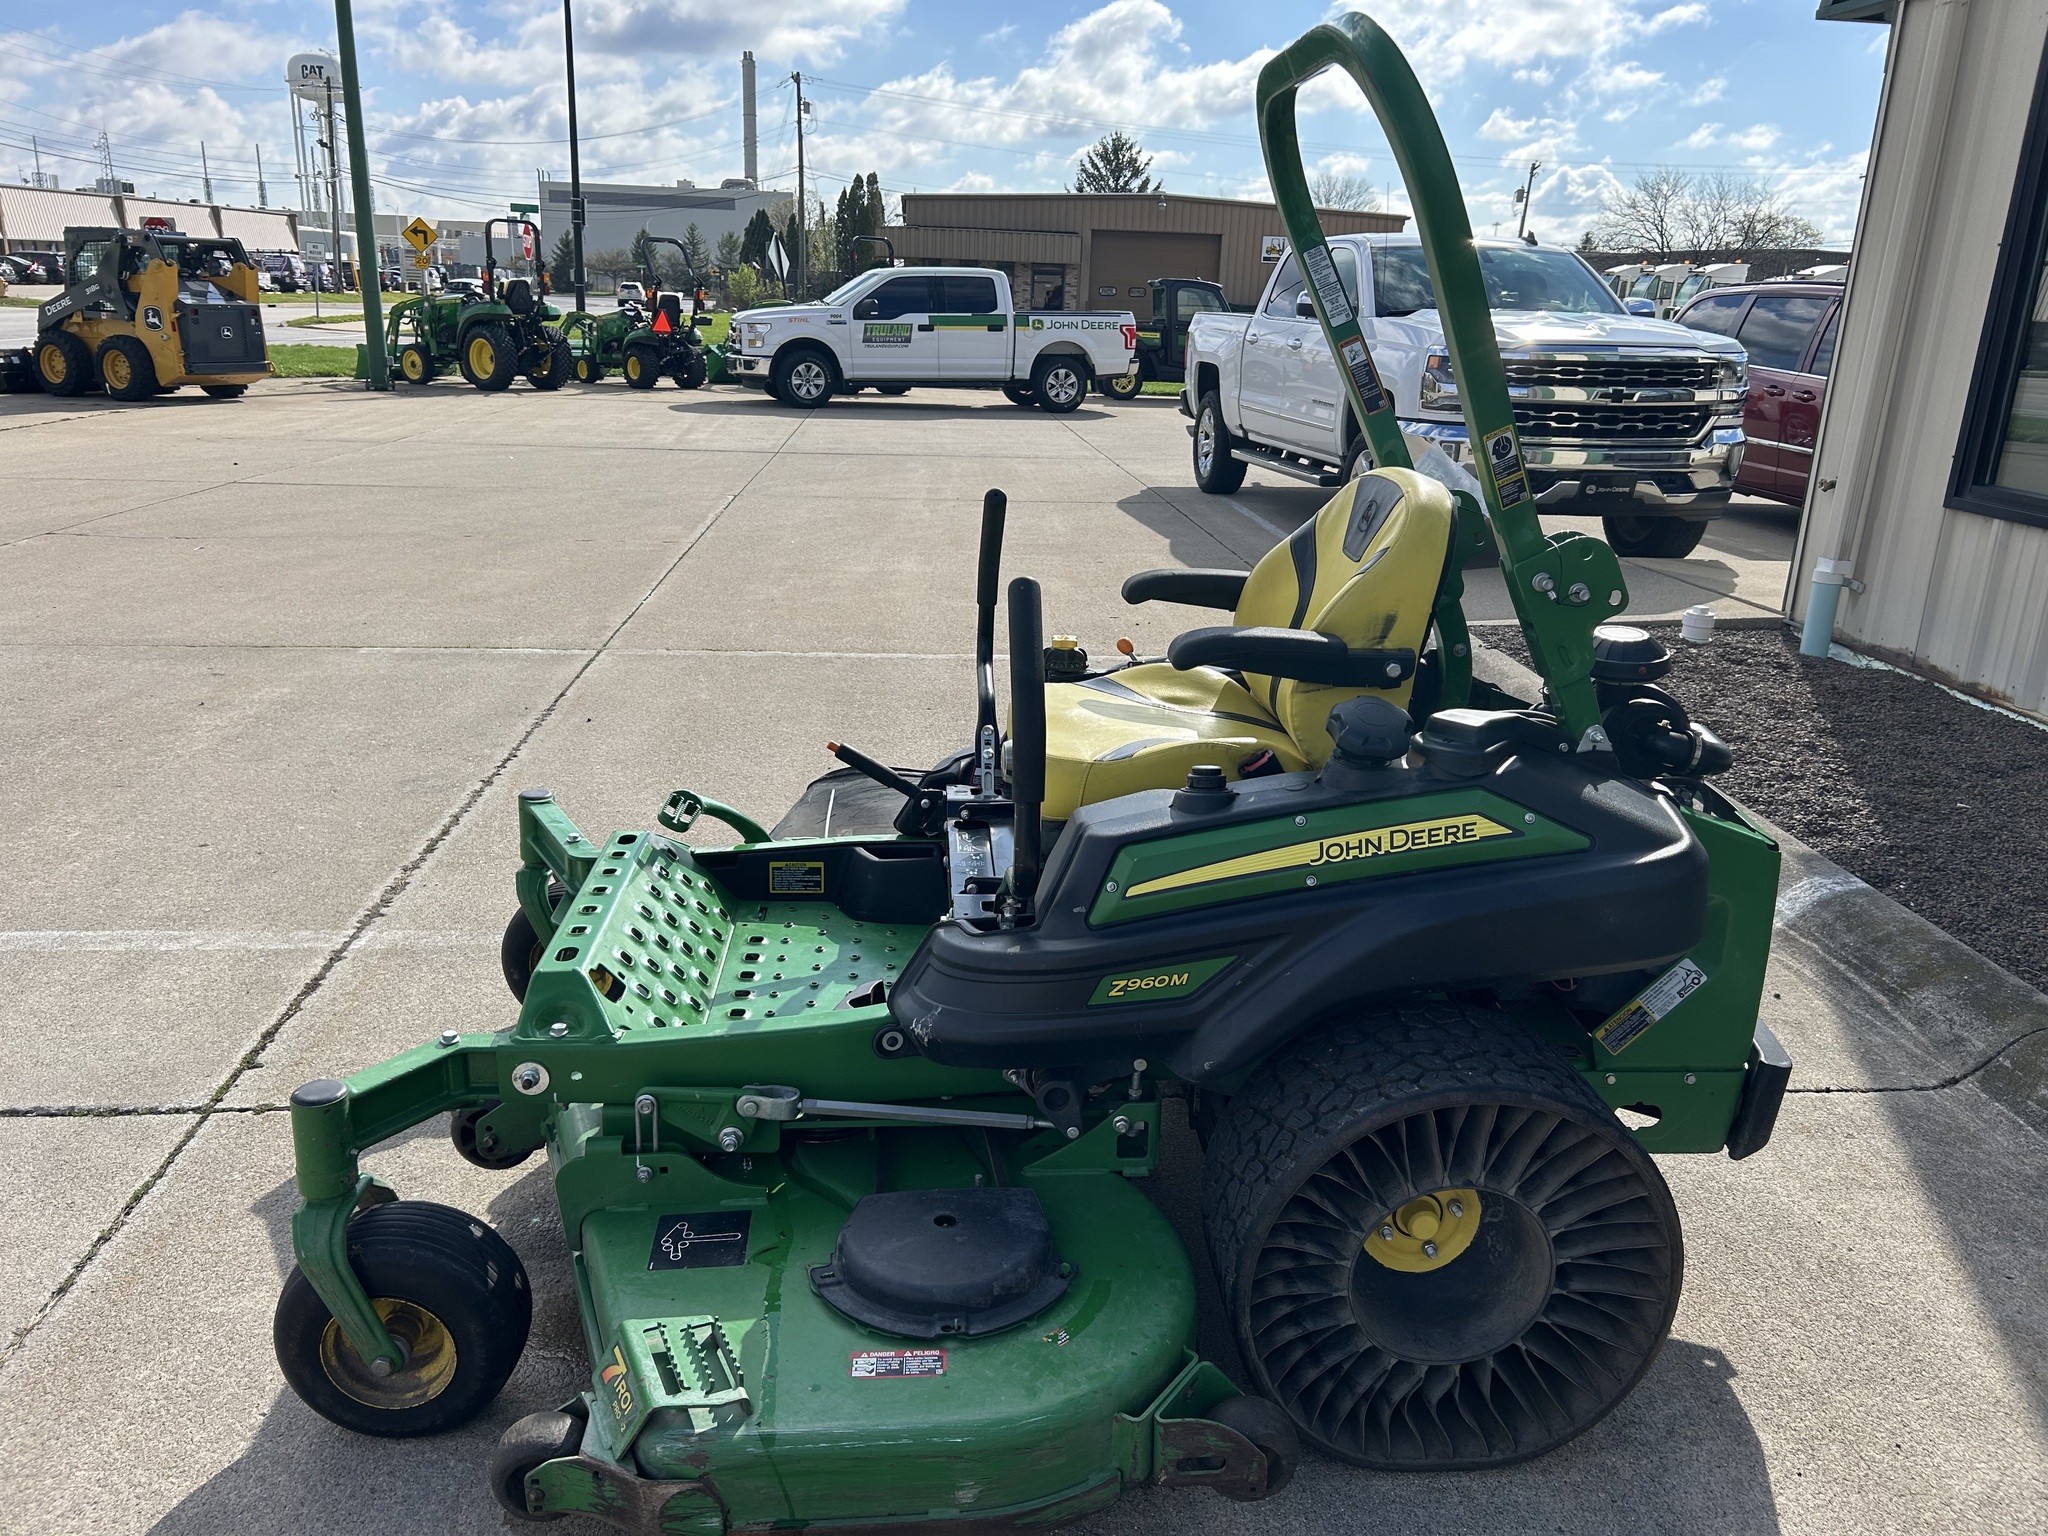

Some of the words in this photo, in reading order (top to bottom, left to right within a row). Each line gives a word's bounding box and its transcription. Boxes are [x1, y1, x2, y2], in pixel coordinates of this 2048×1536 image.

[301, 64, 324, 80] CAT
[416, 256, 428, 265] 20
[84, 283, 100, 295] 318G
[44, 296, 73, 316] DEERE
[865, 324, 911, 336] TRULAND
[1046, 319, 1079, 330] JOHN
[1081, 319, 1119, 330] DEERE
[1309, 836, 1383, 866] JOHN
[1388, 821, 1479, 852] DEERE
[1108, 971, 1190, 997] Z960M
[612, 1400, 622, 1419] PRO
